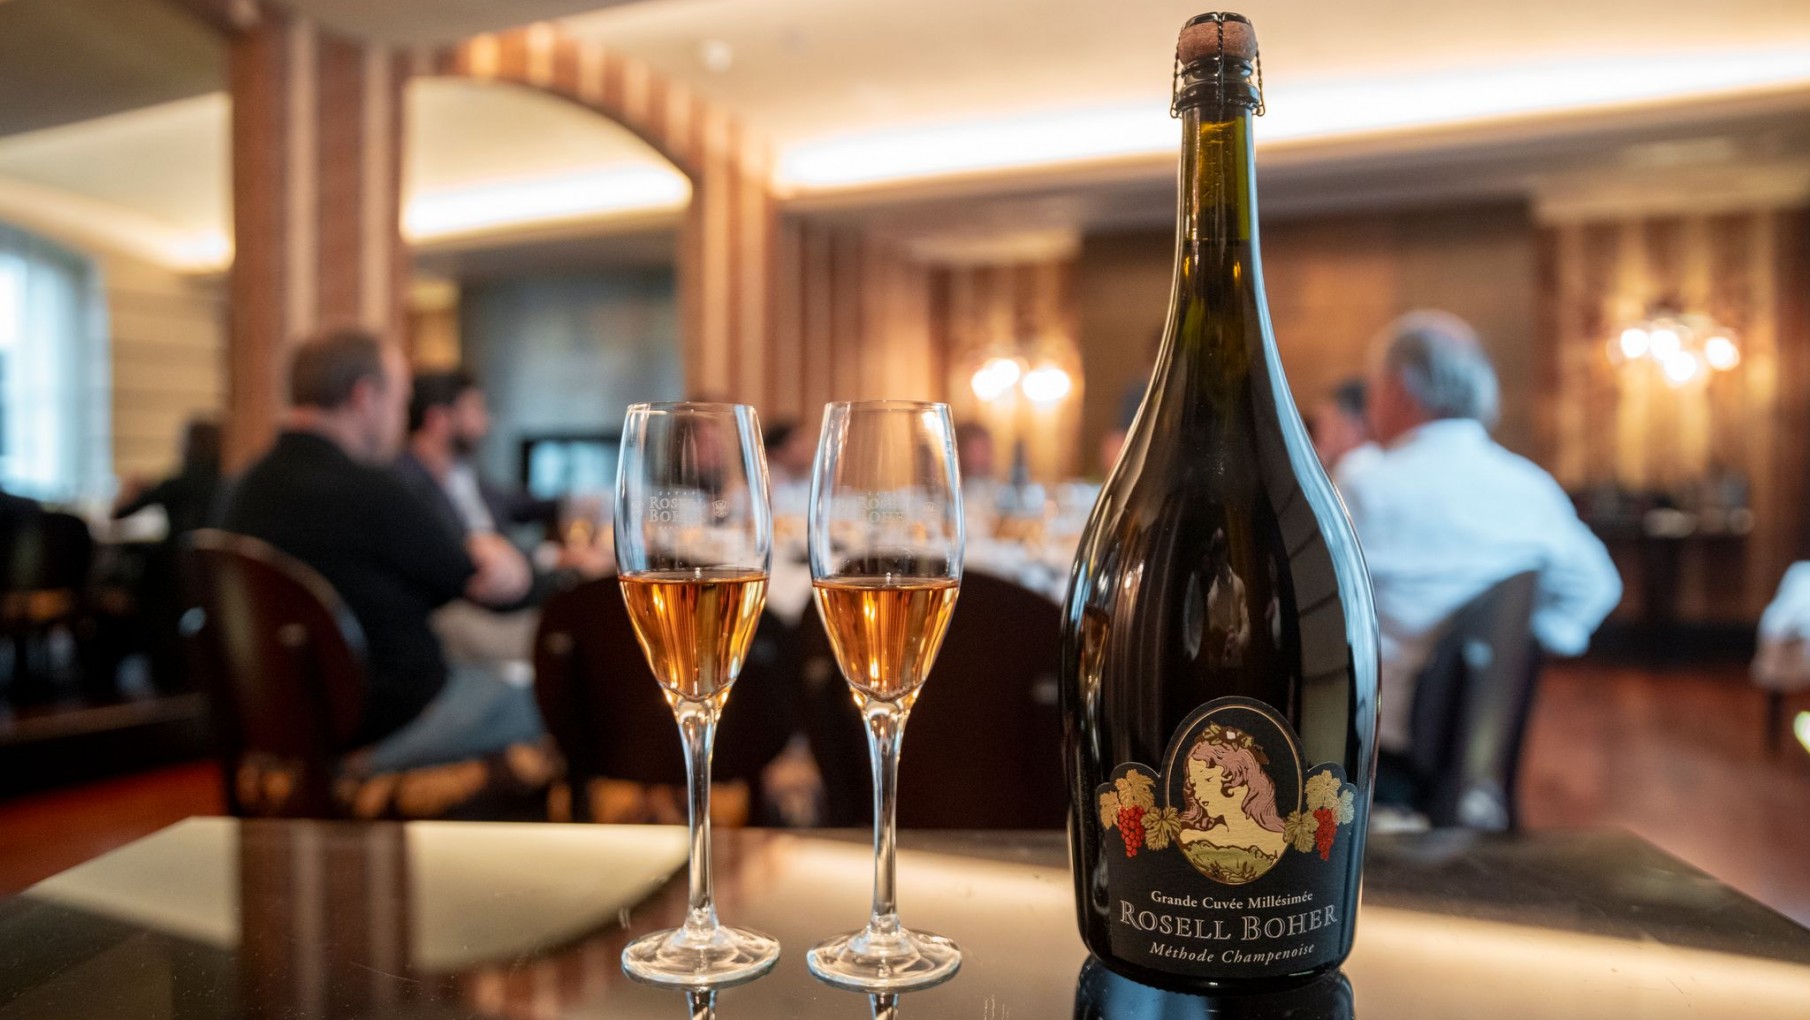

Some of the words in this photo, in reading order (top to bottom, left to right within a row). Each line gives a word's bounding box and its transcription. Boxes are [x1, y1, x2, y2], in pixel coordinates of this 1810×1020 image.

[1150, 890, 1198, 908] Grande
[1202, 897, 1243, 910] Cuvée
[1248, 890, 1314, 910] Millésimée
[1119, 899, 1232, 941] ROSELL
[1240, 904, 1338, 942] BOHER
[1149, 941, 1215, 963] Méthode
[1221, 942, 1315, 965] Champenoise
